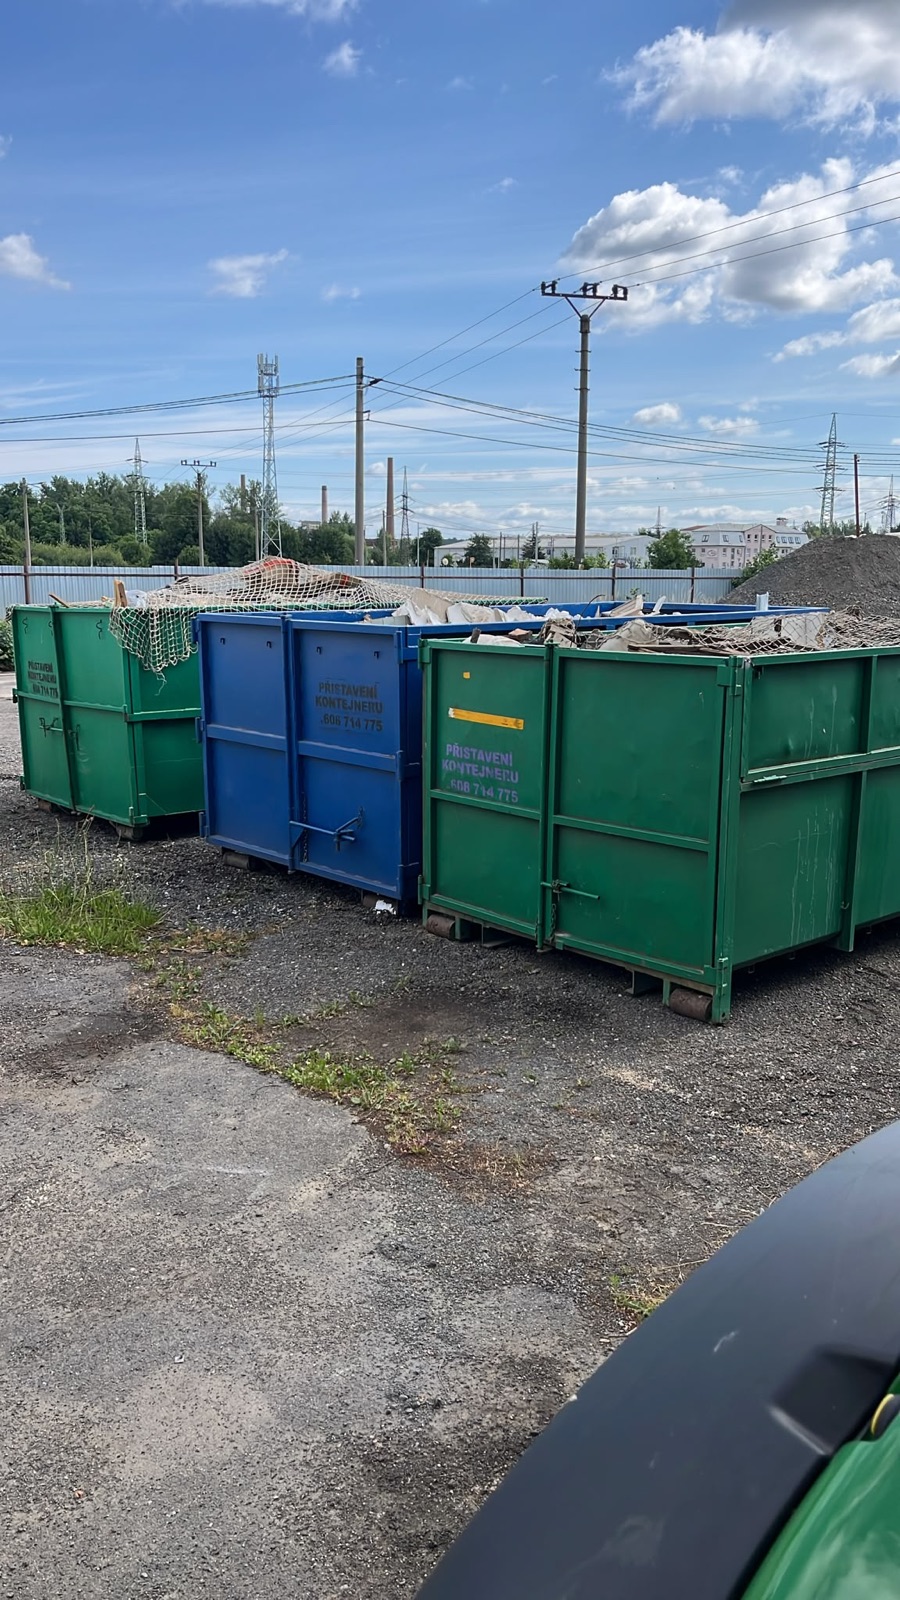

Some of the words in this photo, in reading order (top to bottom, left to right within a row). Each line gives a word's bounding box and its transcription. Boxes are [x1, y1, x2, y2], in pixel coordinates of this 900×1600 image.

[315, 696, 383, 714] KONTEJNERU
[344, 716, 361, 729] 714
[364, 719, 383, 732] 775
[446, 743, 513, 767] PŘISTAVENÍ
[442, 759, 519, 784] KONTEJNERU
[473, 783, 494, 797] 714
[497, 788, 518, 803] 775
